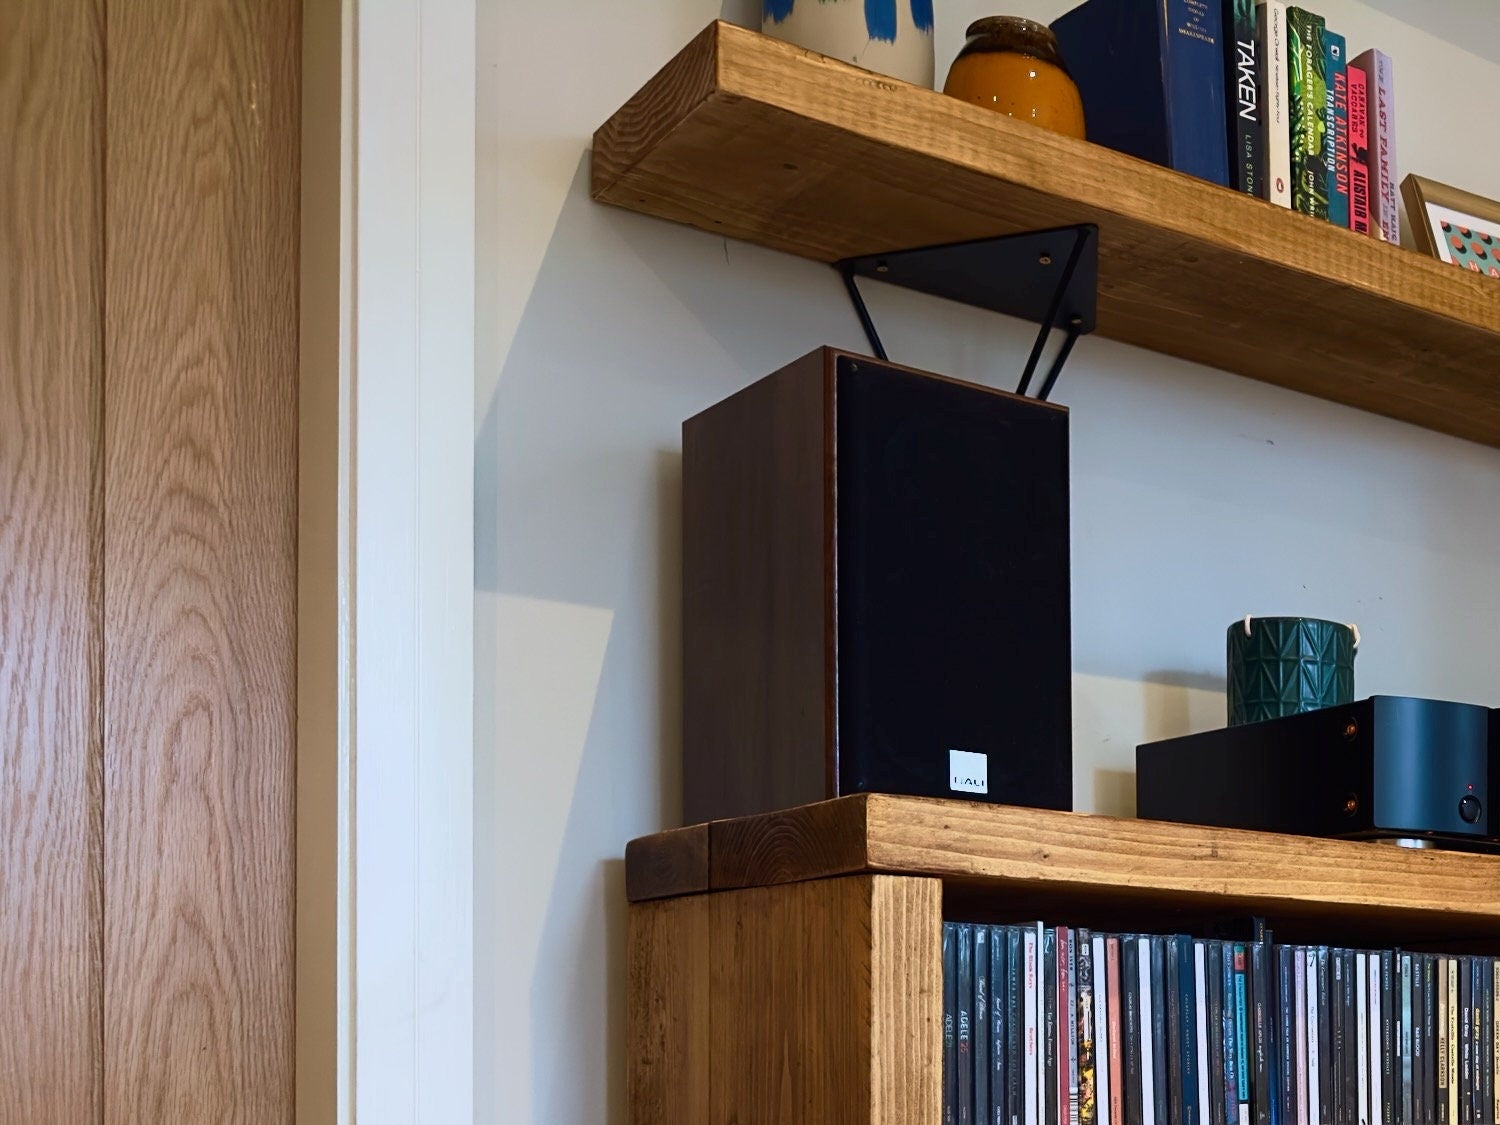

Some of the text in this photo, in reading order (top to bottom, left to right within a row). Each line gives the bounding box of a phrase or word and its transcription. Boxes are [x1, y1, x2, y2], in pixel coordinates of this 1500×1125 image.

[1237, 39, 1257, 122] TAKEN
[1306, 44, 1314, 99] FORAGER'S
[1307, 101, 1316, 156] CALENDAR
[1350, 83, 1359, 133] VACCARES
[1357, 82, 1365, 126] CARAVAN
[1378, 86, 1387, 132] LAST
[1245, 134, 1253, 158] LISA
[1326, 89, 1336, 173] TRANSCRIPTION
[1334, 72, 1349, 195] KATE ATKINSON
[1307, 170, 1315, 195] JOHN
[1353, 169, 1368, 219] ALISTAIR
[1380, 135, 1390, 204] FAMILY
[1389, 182, 1397, 212] MATT
[945, 1013, 953, 1040] ADELE
[960, 1010, 969, 1040] ADELE
[1439, 1037, 1448, 1086] KELLY CLARKSON
